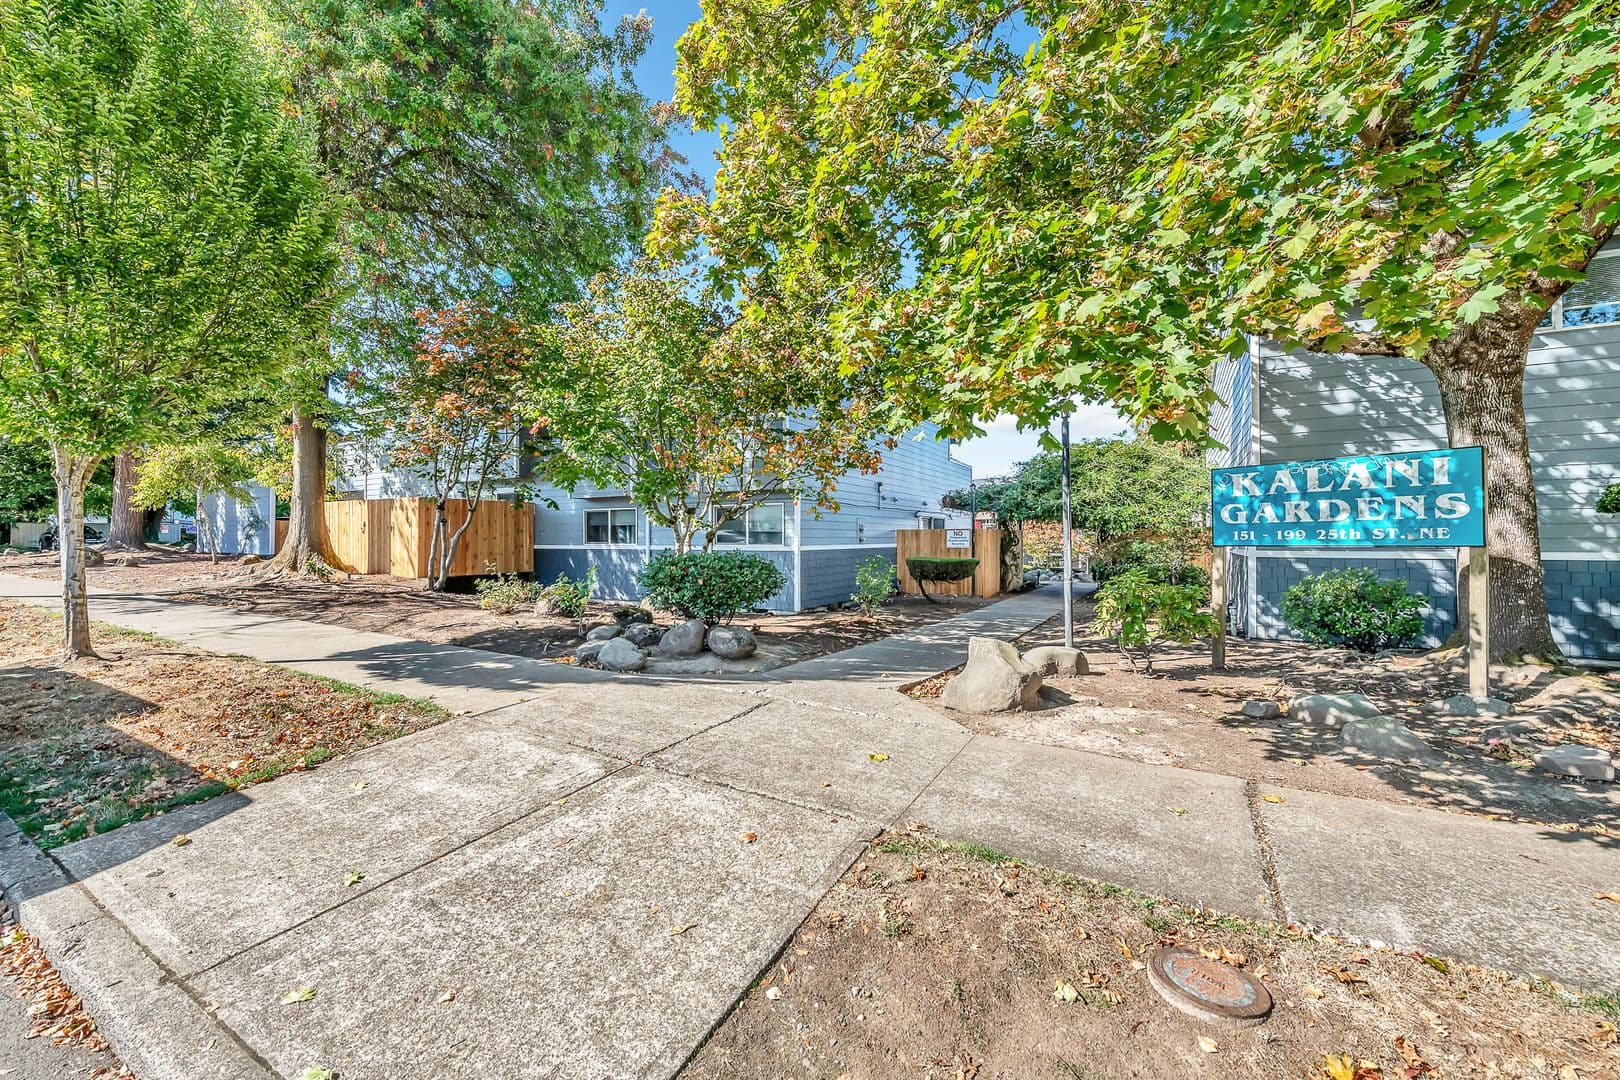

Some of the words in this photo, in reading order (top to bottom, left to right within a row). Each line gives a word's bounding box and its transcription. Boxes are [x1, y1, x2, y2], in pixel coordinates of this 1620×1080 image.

[1232, 456, 1452, 497] KALANI
[1220, 492, 1471, 524] GARDENS
[1233, 530, 1255, 541] 151
[1276, 530, 1307, 541] 199
[1315, 529, 1361, 540] 25th
[1418, 527, 1452, 539] NE
